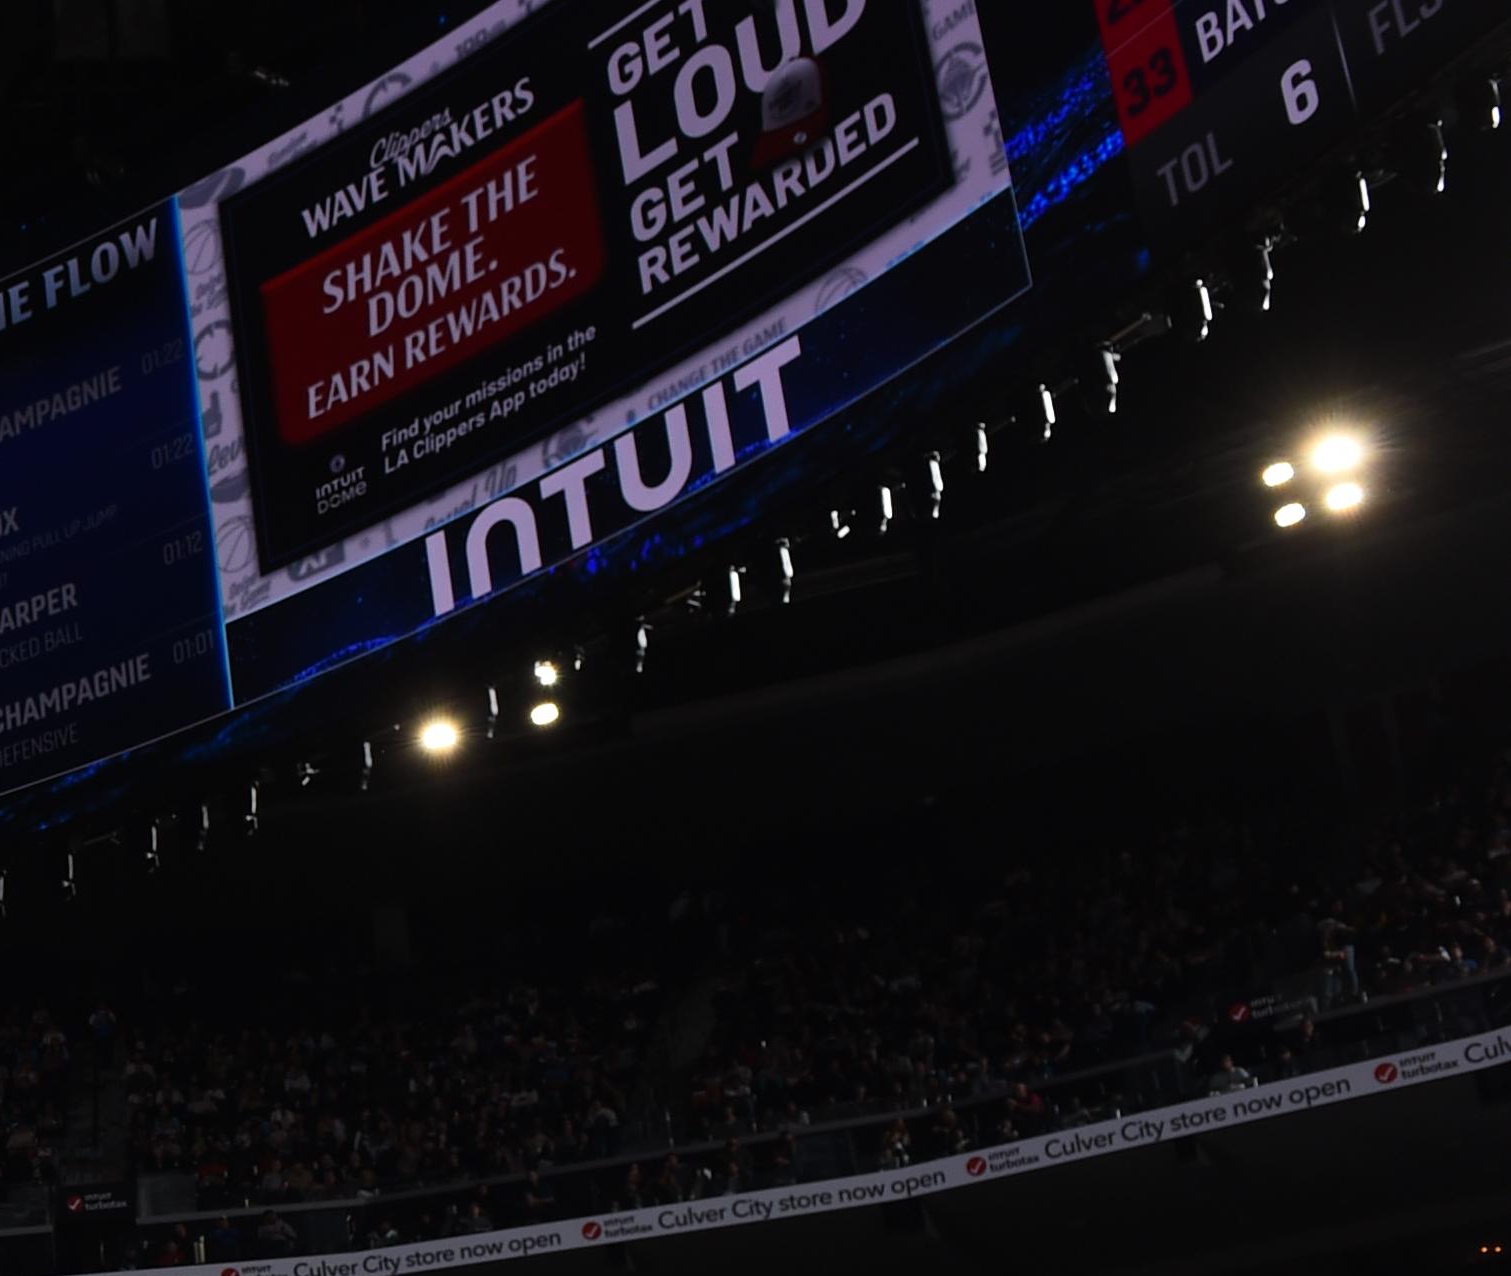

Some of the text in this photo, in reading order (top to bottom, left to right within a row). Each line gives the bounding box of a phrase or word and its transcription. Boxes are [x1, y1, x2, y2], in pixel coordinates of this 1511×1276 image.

[606, 0, 709, 97] GET
[613, 0, 868, 186] LOUD
[1123, 47, 1178, 118] 33
[299, 75, 535, 239] WAVE MAKERS
[368, 107, 455, 170] Clippers
[630, 131, 739, 243] GET
[637, 92, 898, 296] REWARDED
[1157, 59, 1320, 207] TOL 6
[41, 216, 157, 311] FLOW
[322, 154, 539, 314] SHAKE THE
[367, 235, 499, 337] DOME.
[306, 247, 577, 420] EARN REWARDS.
[380, 325, 597, 453] Find your missions in the
[383, 352, 586, 475] LA Clippers App today!
[425, 333, 802, 618] INTUIT
[44, 621, 83, 653] BALL
[1045, 1077, 1352, 1160] Culver City store now open
